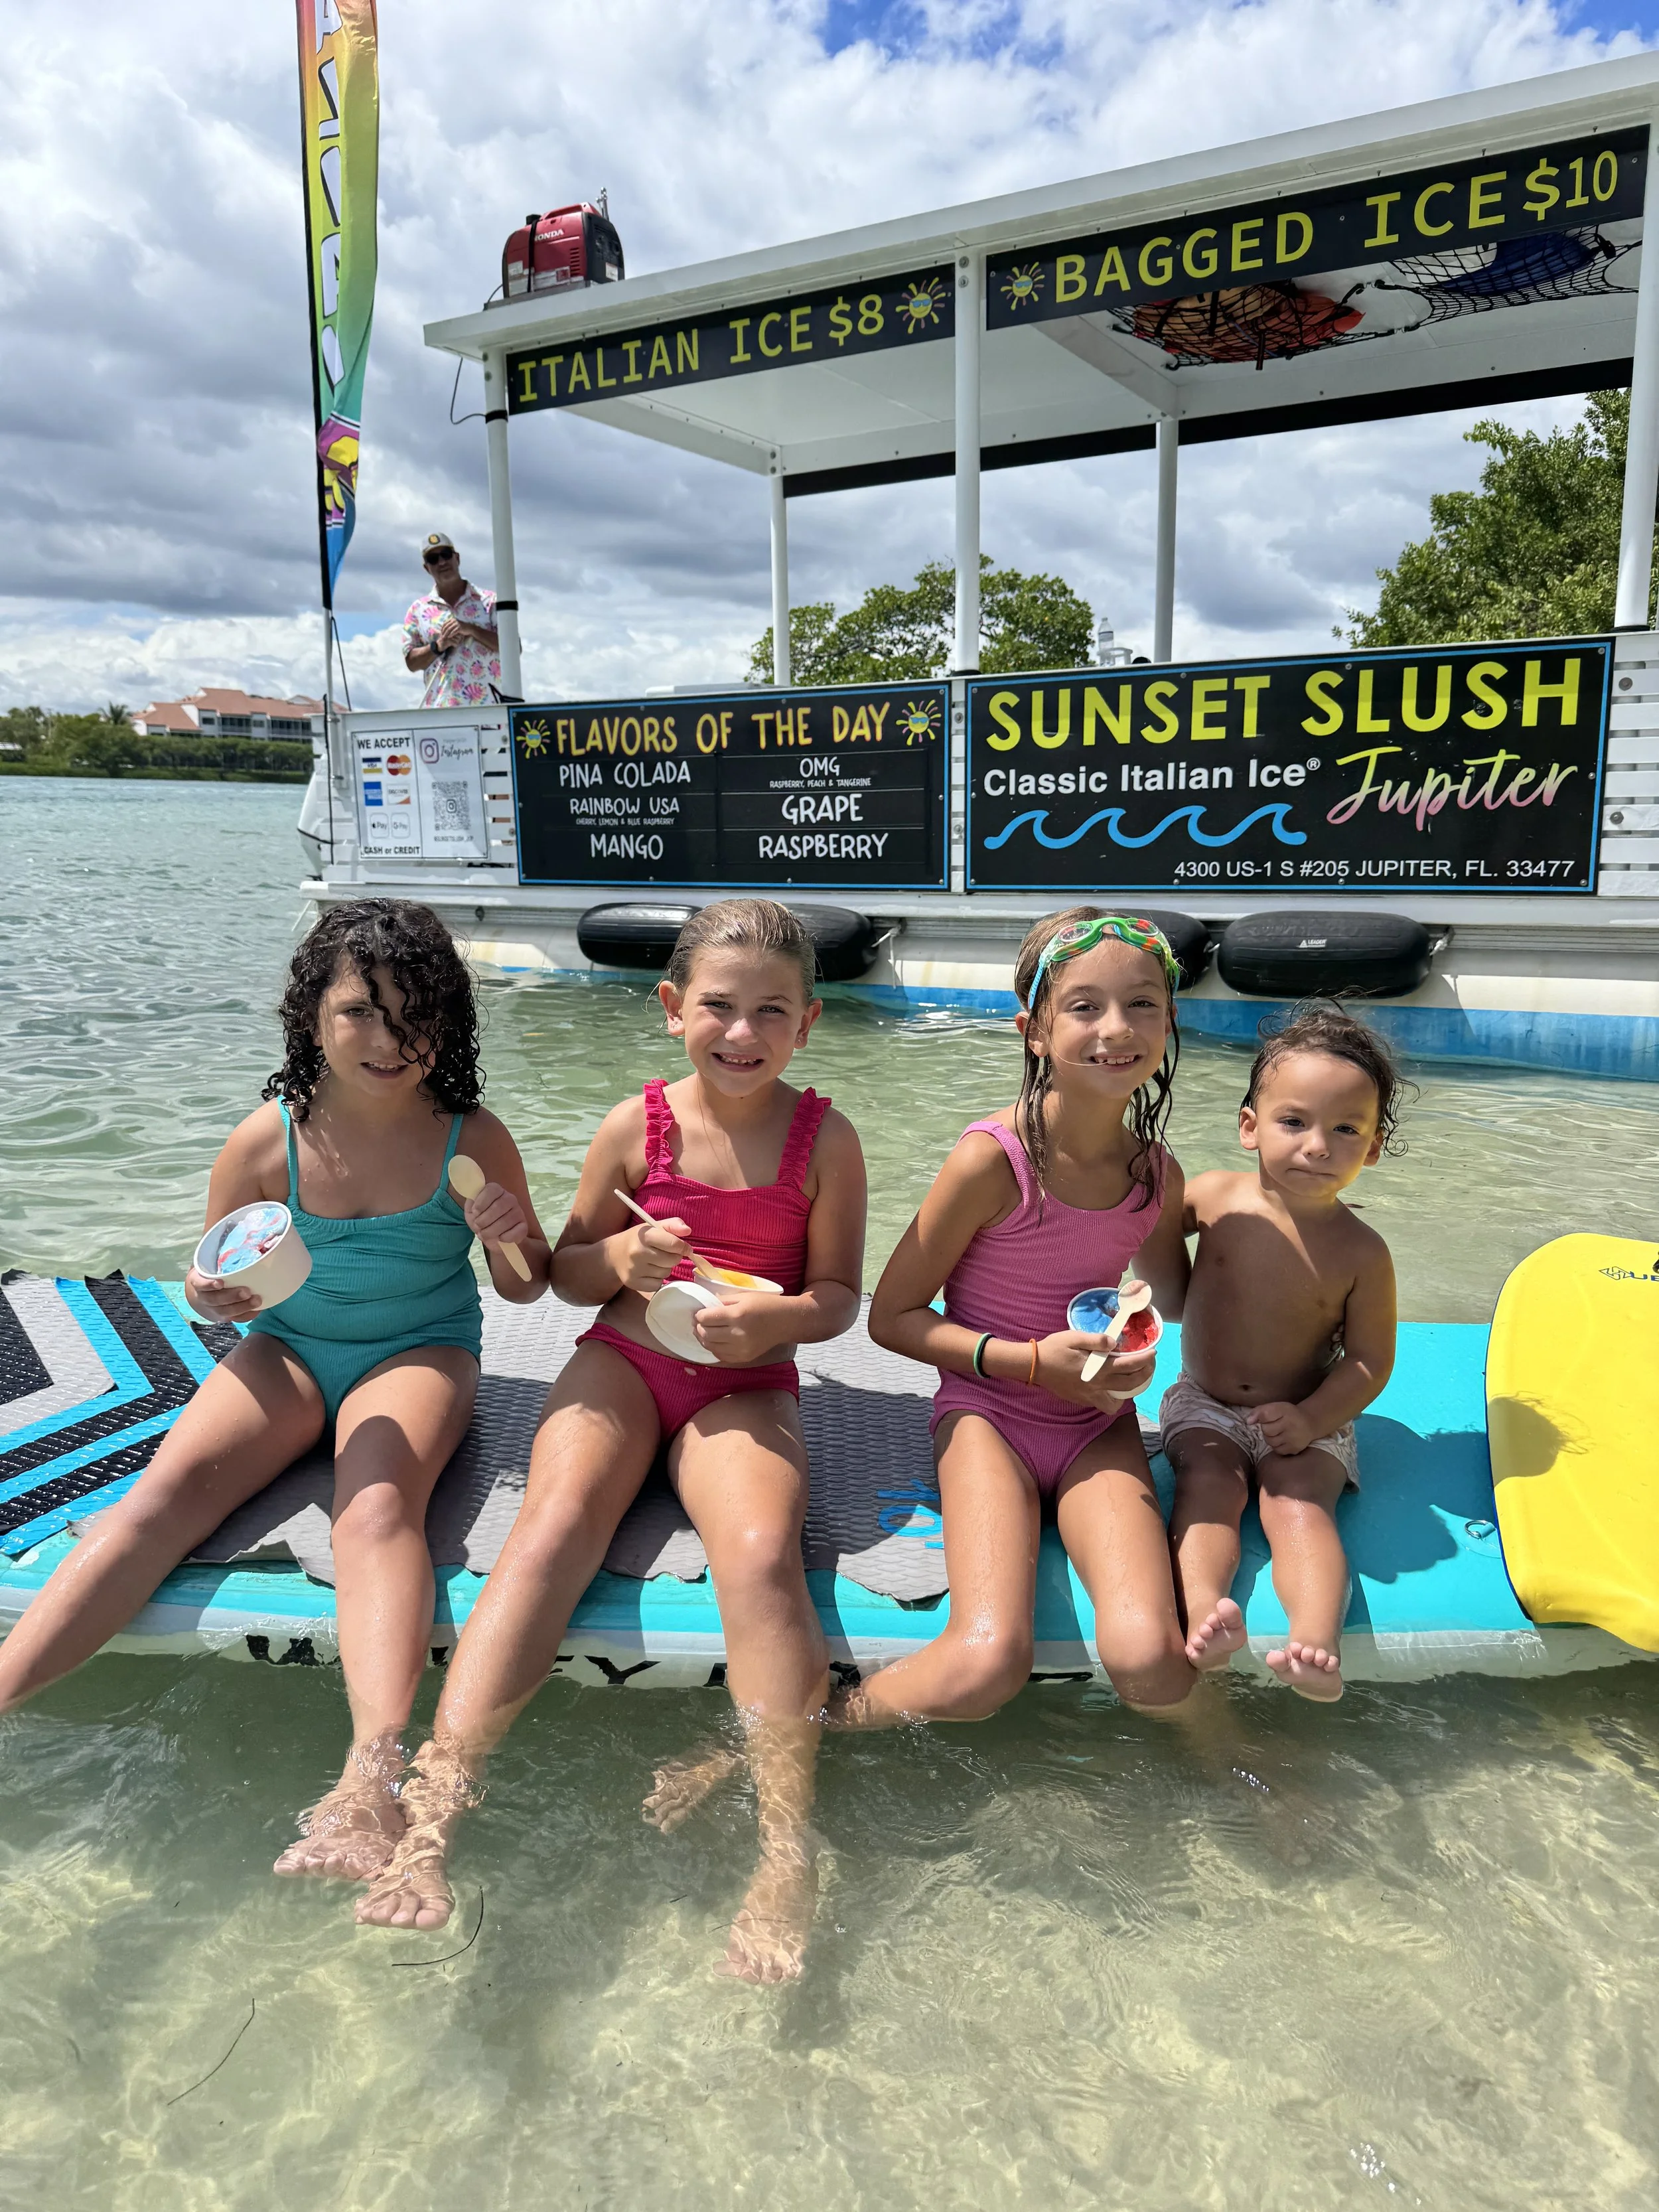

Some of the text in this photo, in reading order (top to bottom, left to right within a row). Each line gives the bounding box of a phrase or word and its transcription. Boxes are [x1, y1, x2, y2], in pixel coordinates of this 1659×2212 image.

[1055, 150, 1619, 303] BAGGED ICE $10
[518, 294, 884, 402] ITALIAN ICE $8
[985, 658, 1579, 751] SUNSET SLUSH
[357, 737, 411, 749] WE ACCEPT
[557, 701, 891, 756] FLAVORS OF THE DAY
[559, 761, 691, 789] PINA COLADA
[800, 756, 840, 778] OMG
[836, 777, 871, 786] TANGERINE
[983, 766, 1108, 797] Classic
[1121, 761, 1234, 792] Italian
[1326, 745, 1578, 832] Jupiter
[570, 797, 679, 816] RAINBOW USA
[781, 794, 863, 824] GRAPE
[591, 832, 889, 860] MANGO RASPBERRY
[1174, 860, 1575, 878] 4300 US-1 S #205 JUPITER, FL. 33477
